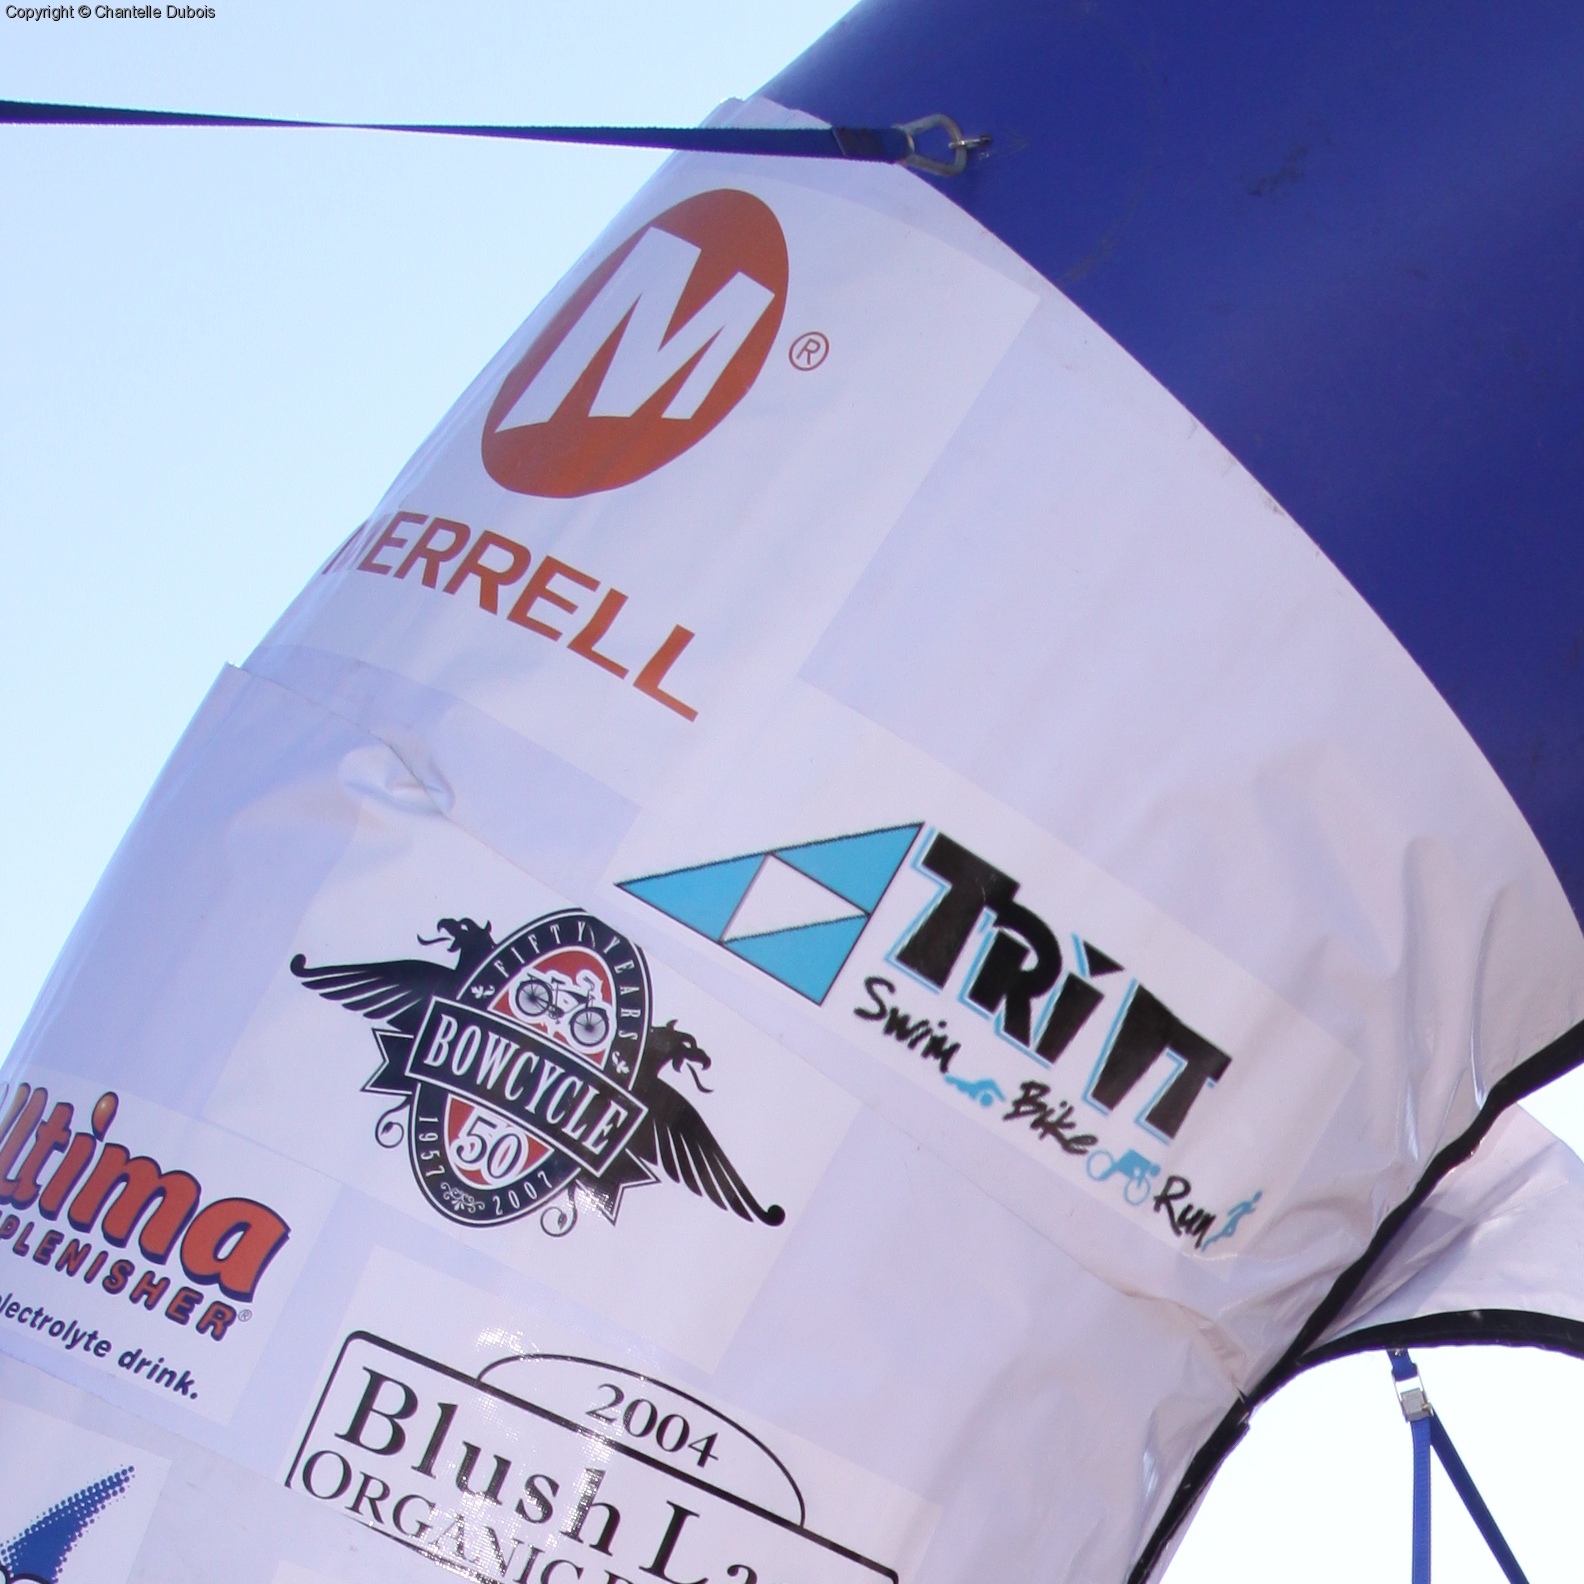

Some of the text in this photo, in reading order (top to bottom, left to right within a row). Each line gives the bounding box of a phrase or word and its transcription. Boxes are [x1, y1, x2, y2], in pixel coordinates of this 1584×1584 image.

[493, 920, 642, 1041] FIFTY YEARS
[423, 1013, 629, 1155] BOWCYCLE
[854, 976, 1218, 1249] Swim Bike Run
[418, 1115, 446, 1178] 1957
[453, 1113, 524, 1181] 50
[492, 1170, 553, 1216] 2007
[0, 1291, 199, 1400] lectrolyte drink.
[334, 1366, 622, 1557] Blush
[584, 1382, 720, 1468] 2004
